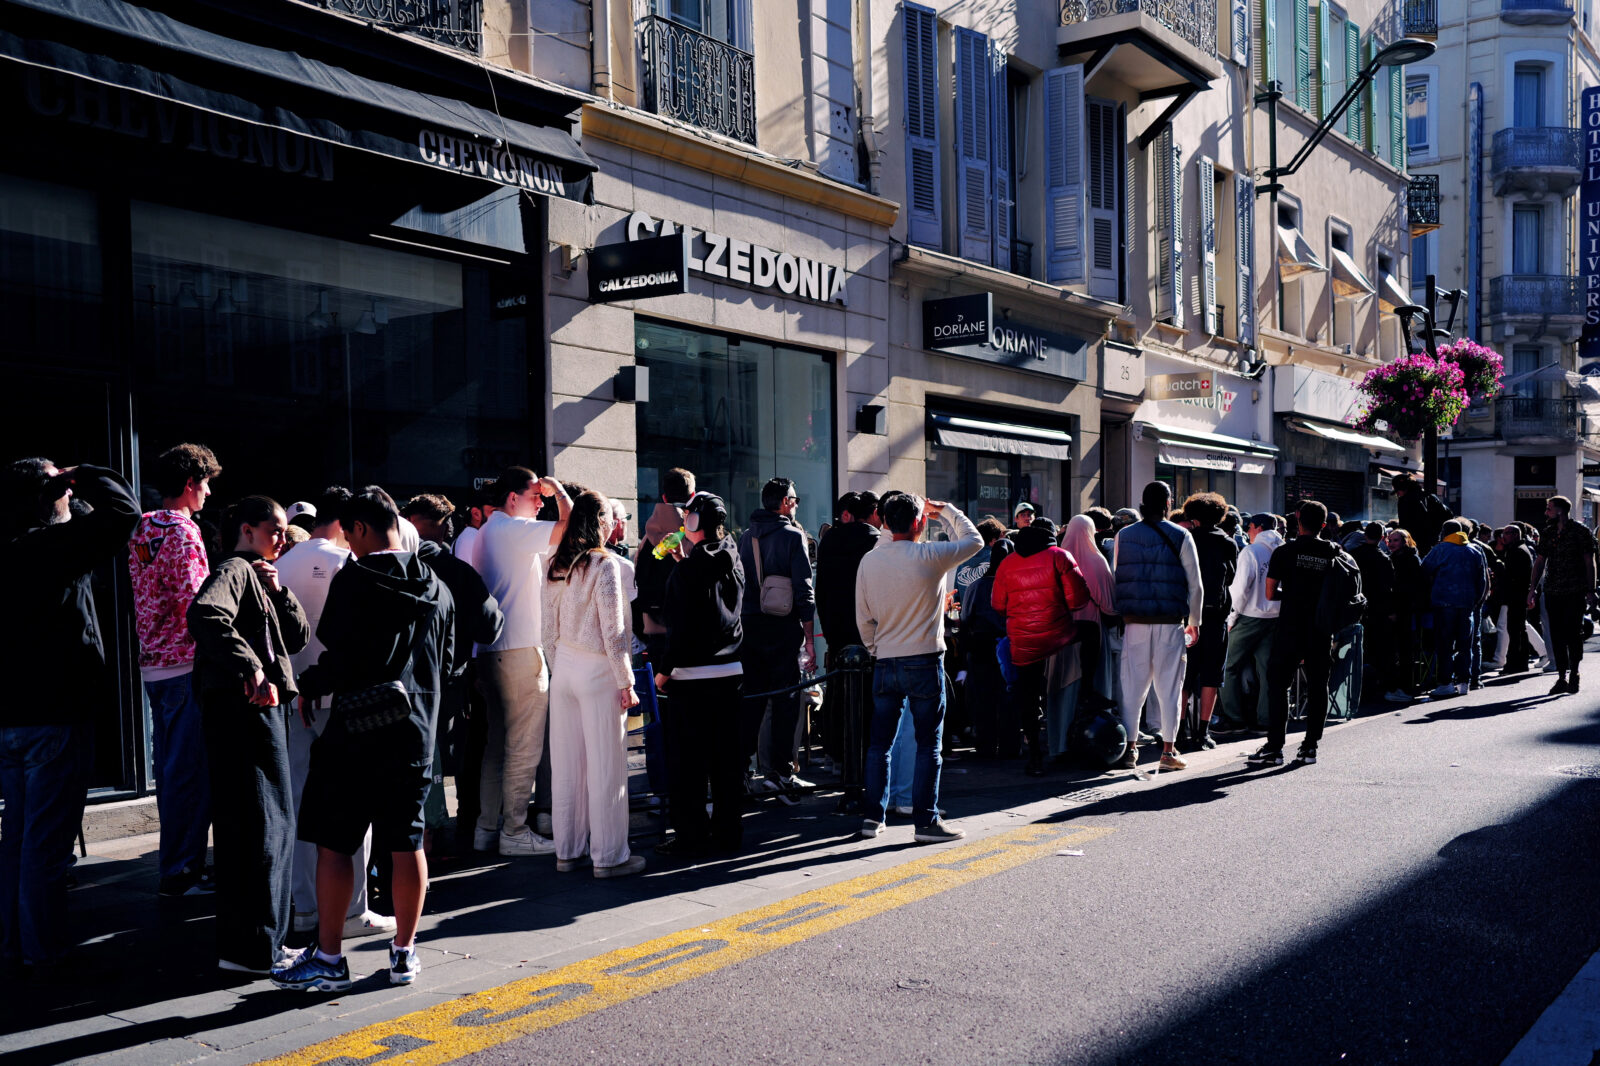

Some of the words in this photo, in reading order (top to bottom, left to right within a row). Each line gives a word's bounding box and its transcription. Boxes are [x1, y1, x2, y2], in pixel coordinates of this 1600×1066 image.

[418, 129, 566, 197] CHEVIGNON
[599, 270, 678, 292] CALZEDONIA
[933, 320, 986, 338] DORIANE
[991, 326, 1048, 360] ORIANE
[1120, 365, 1130, 381] 25
[1156, 379, 1201, 392] watch
[1177, 386, 1224, 411] watch
